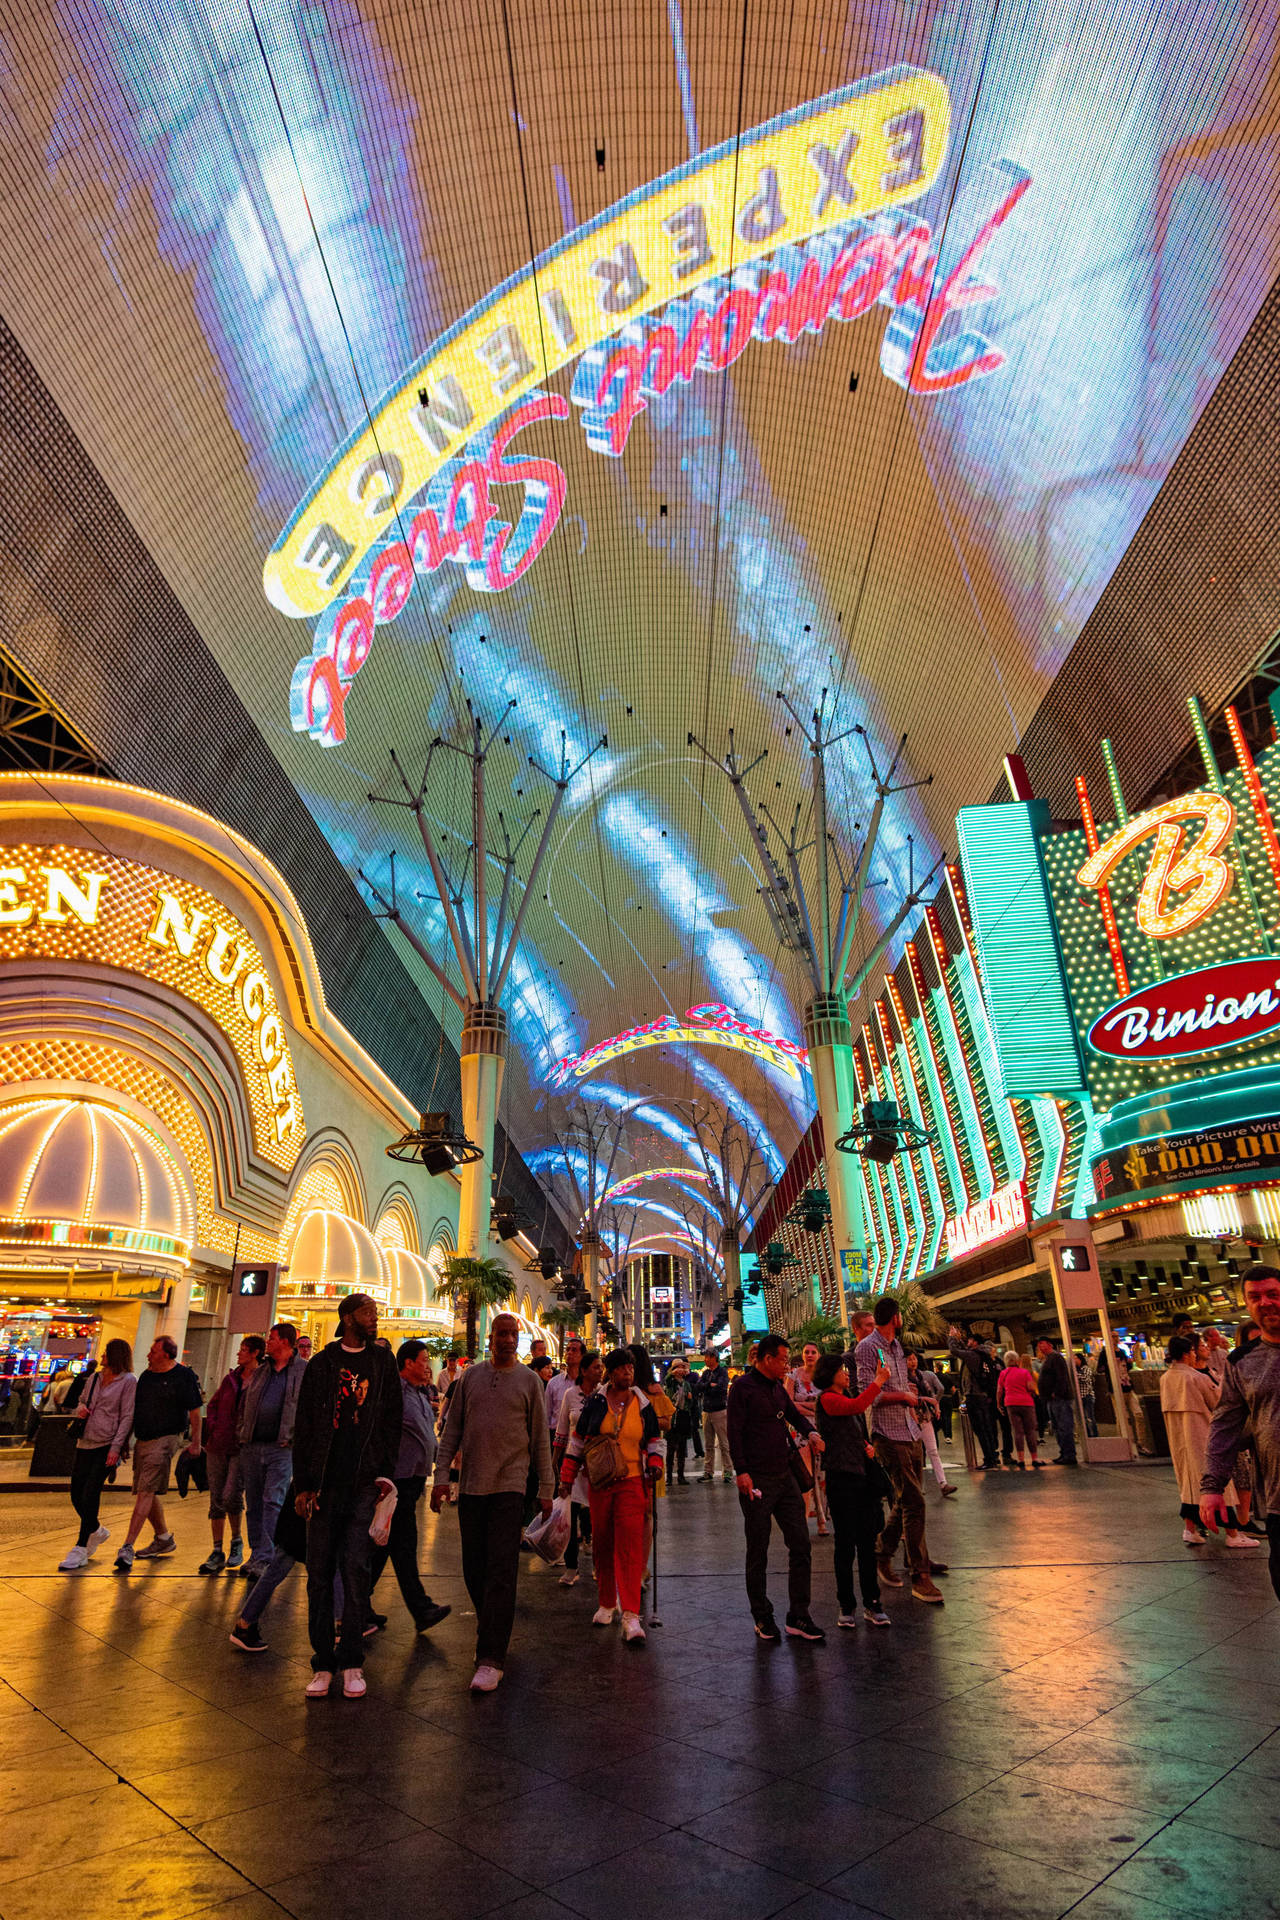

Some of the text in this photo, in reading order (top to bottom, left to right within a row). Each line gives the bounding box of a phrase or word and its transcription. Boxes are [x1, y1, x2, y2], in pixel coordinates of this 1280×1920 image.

[299, 106, 928, 590] EXPERIENCE
[291, 158, 1033, 747] Fremont Street
[1077, 792, 1236, 939] B
[142, 890, 297, 1145] NUGGET
[544, 1014, 679, 1087] Fremont
[579, 1030, 790, 1073] EXPERIENCE
[1135, 1121, 1280, 1156] Take Your Picture Wit
[1195, 1165, 1222, 1175] Binion's
[1235, 1161, 1260, 1169] details
[845, 1251, 862, 1259] ZOOM
[848, 1265, 863, 1276] 35
